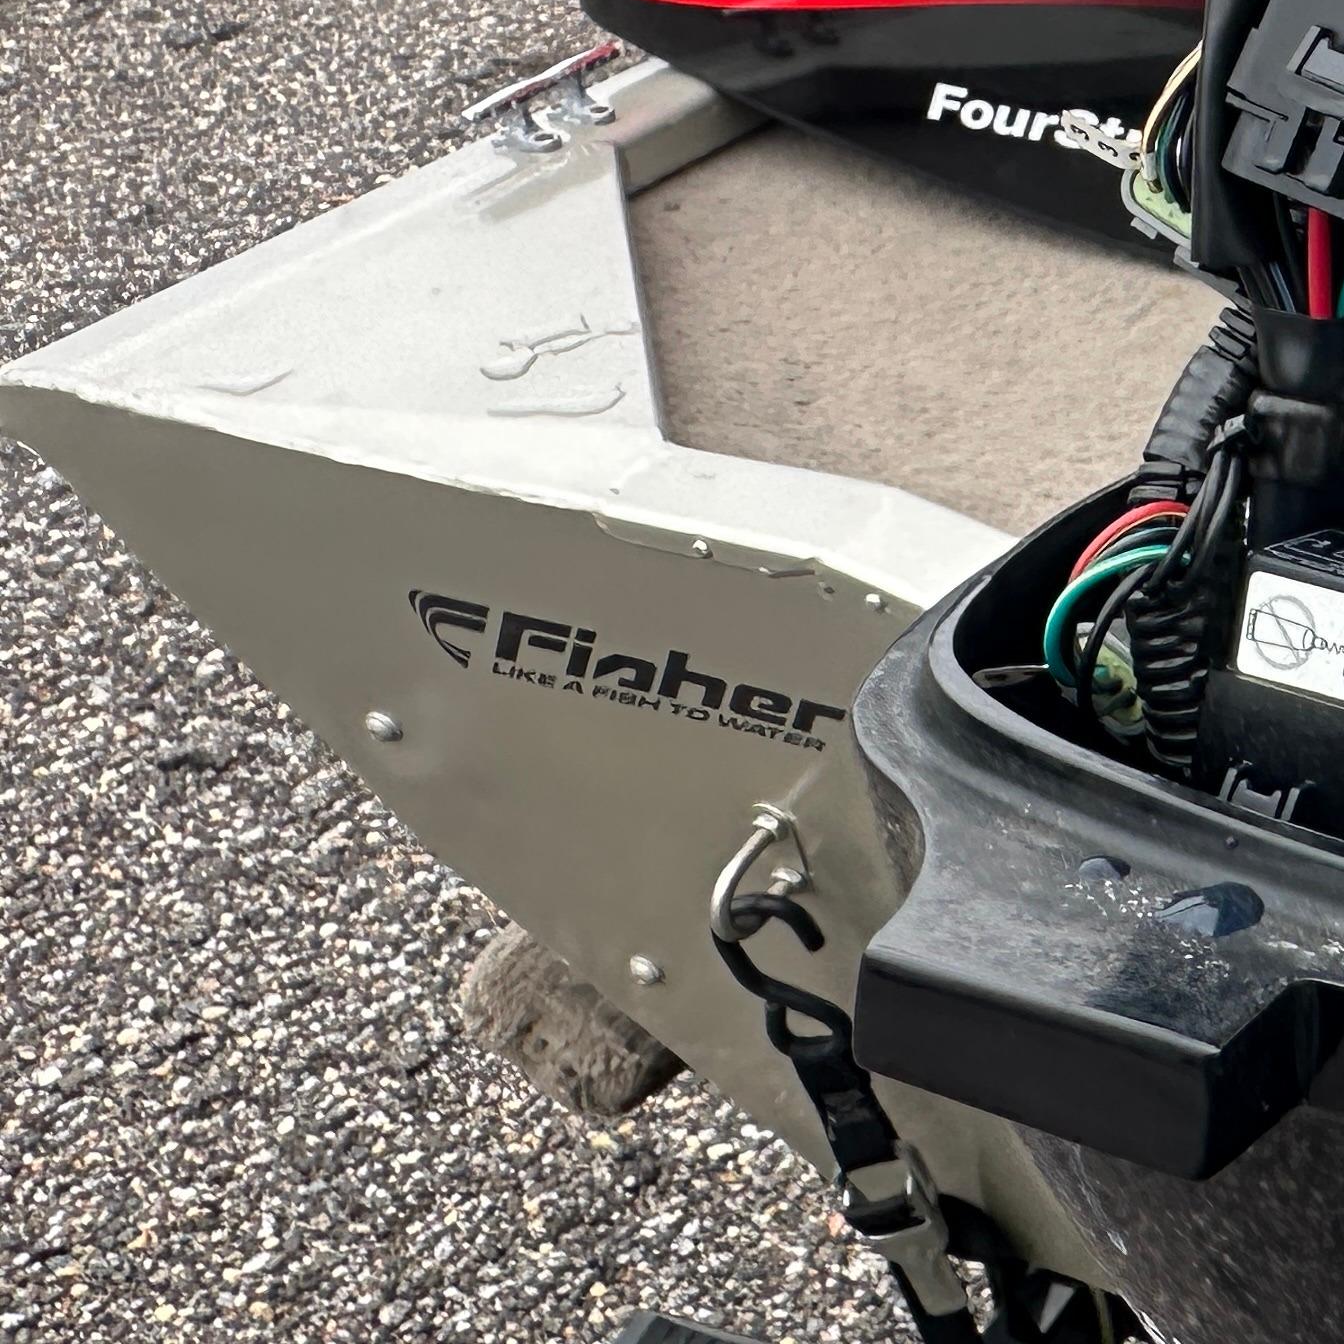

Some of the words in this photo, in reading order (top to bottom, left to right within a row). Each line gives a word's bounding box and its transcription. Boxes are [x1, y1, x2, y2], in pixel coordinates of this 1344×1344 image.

[926, 81, 1144, 149] FourSt
[492, 661, 557, 690] LIKE
[562, 679, 585, 696] A
[671, 702, 711, 723] TO
[718, 713, 828, 754] WATER
[495, 611, 848, 734] Fisher
